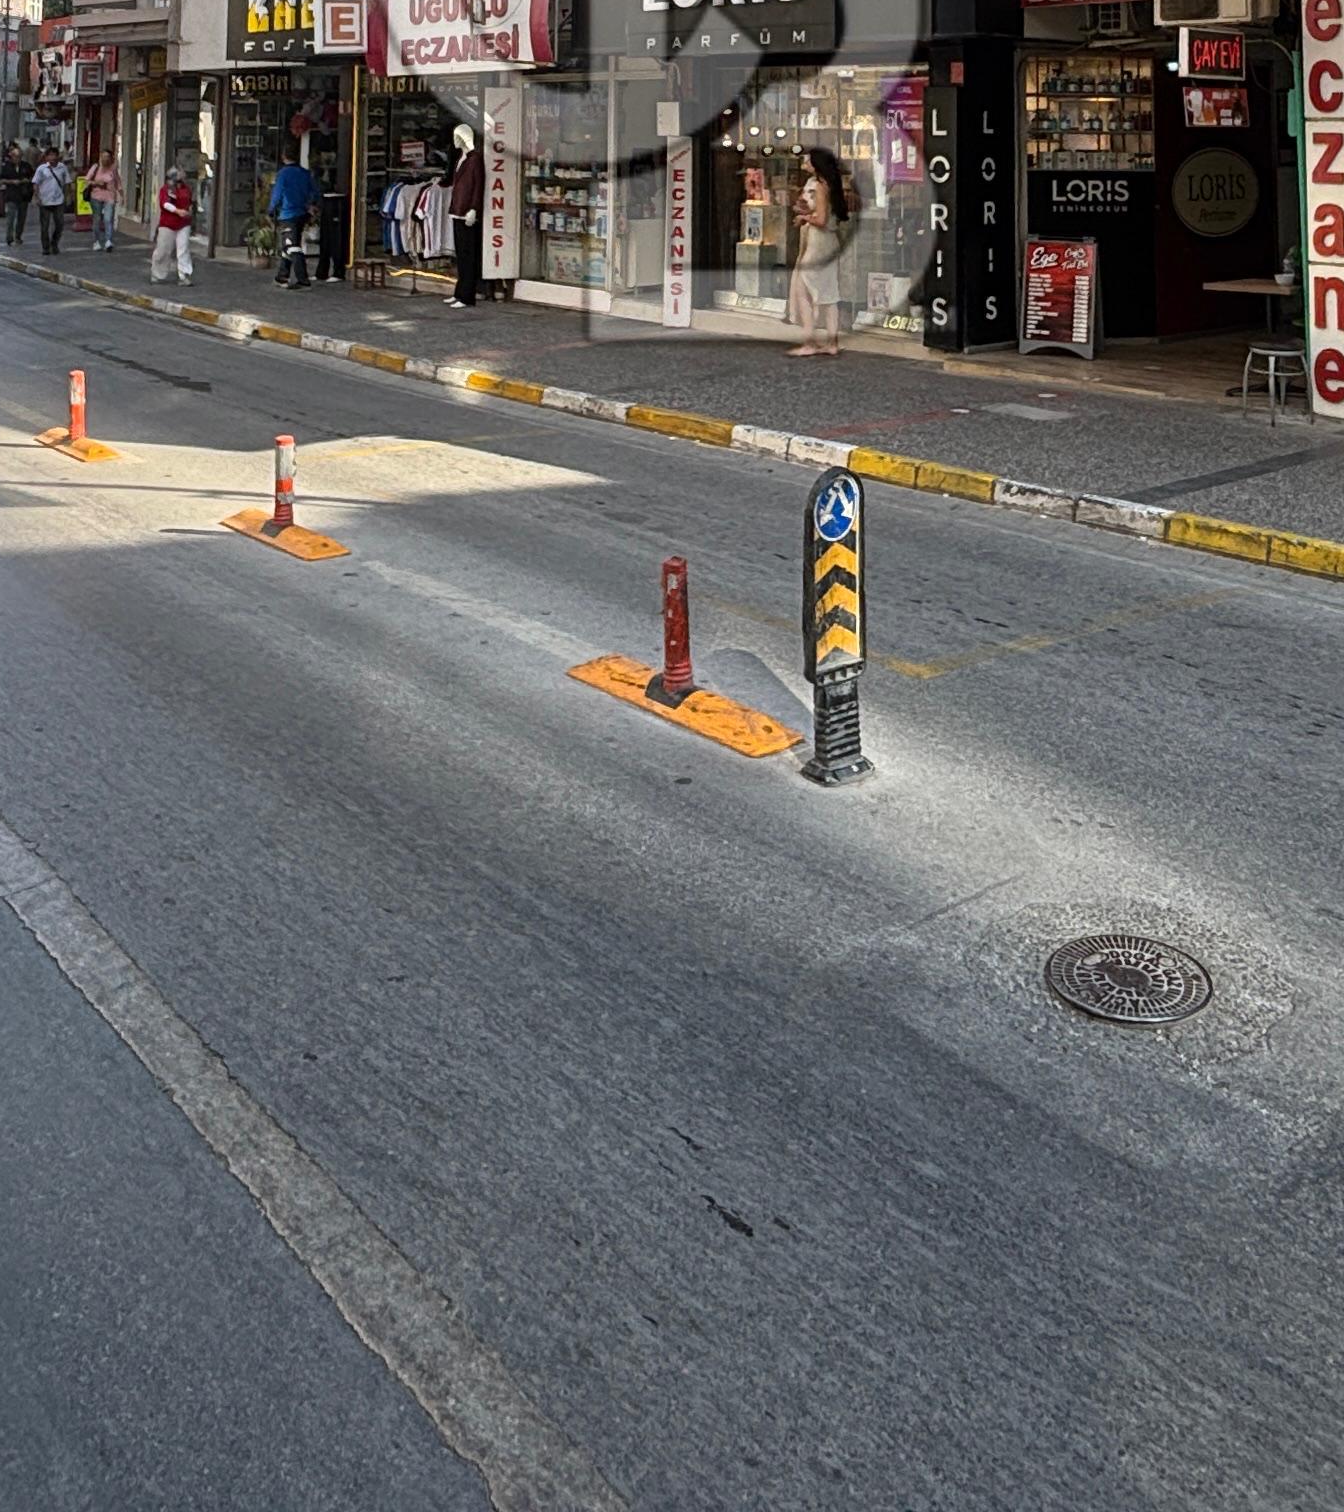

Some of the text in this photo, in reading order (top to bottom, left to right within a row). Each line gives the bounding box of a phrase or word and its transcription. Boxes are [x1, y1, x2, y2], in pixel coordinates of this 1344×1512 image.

[400, 23, 520, 67] ECZANESİ
[646, 28, 806, 50] PARFÜM
[1193, 36, 1241, 72] ÇAY EVİ
[491, 120, 507, 268] ECZANESİ
[1052, 179, 1130, 203] LORIS
[928, 108, 951, 326] LORIS
[981, 110, 998, 321] LORIS
[882, 314, 921, 333] LORIS
